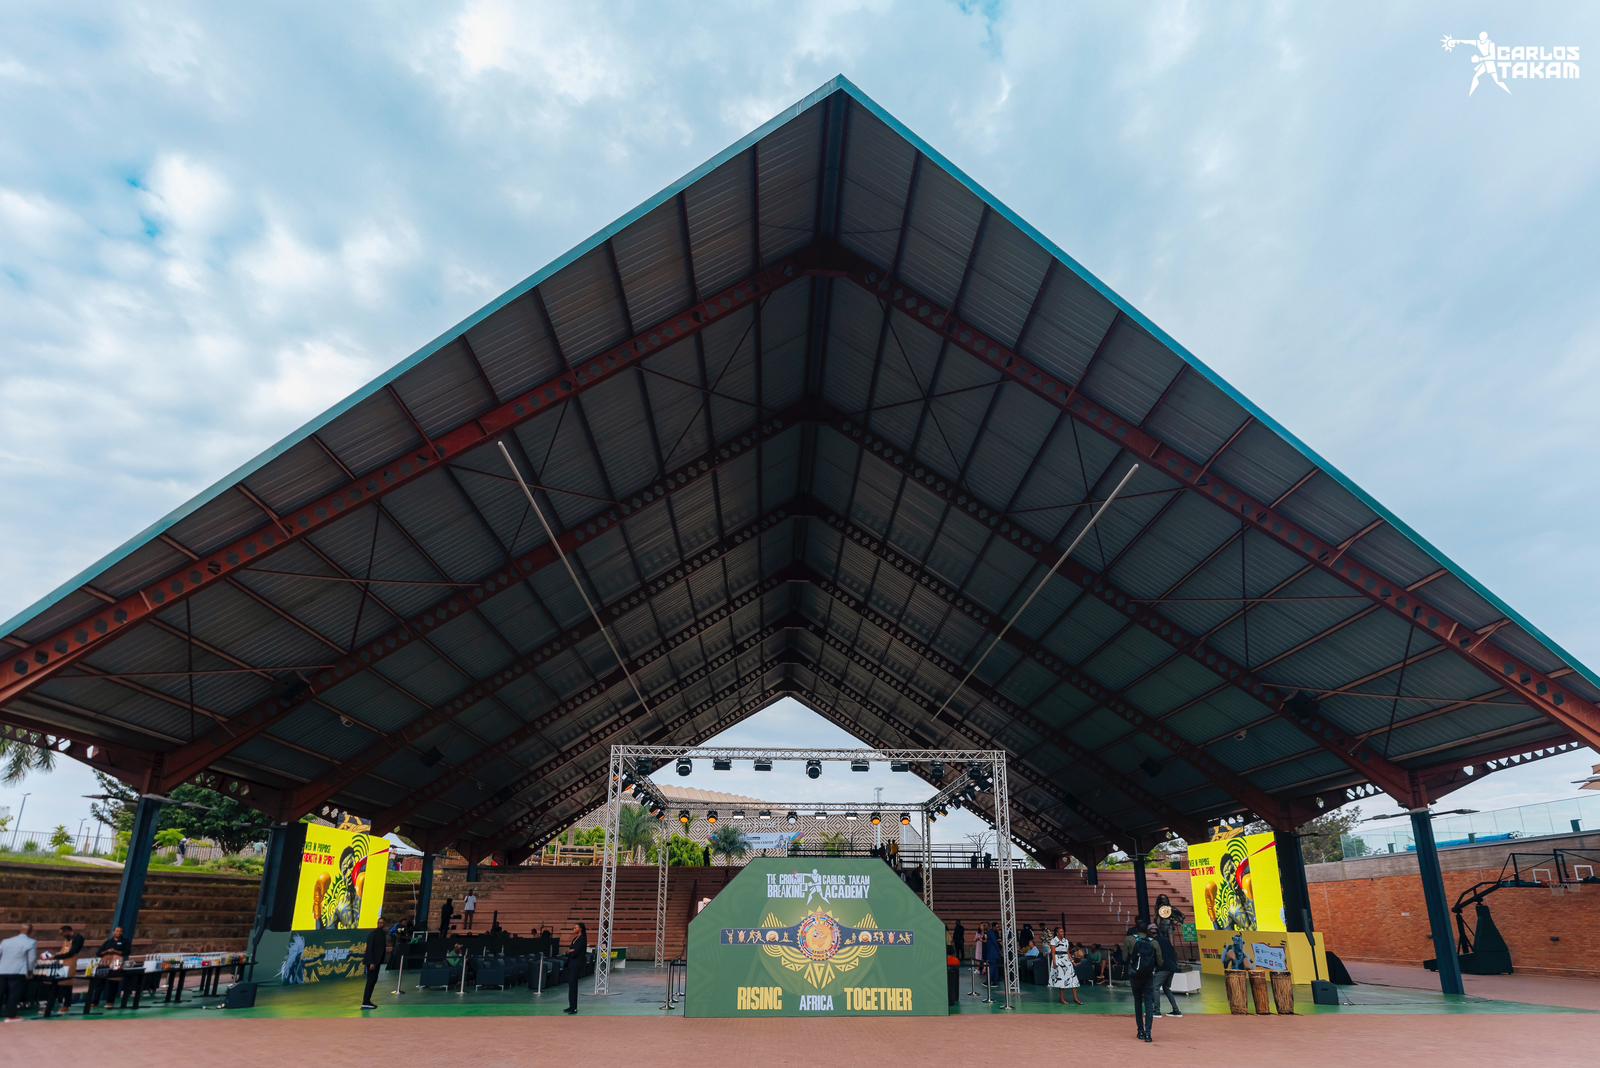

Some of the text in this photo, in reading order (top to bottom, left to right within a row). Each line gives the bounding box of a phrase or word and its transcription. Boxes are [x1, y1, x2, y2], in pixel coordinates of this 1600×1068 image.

[822, 875, 870, 885] CARLOS TAKAM
[767, 884, 805, 898] BREAKING
[824, 885, 870, 899] ACADEMY
[737, 987, 912, 1011] RISING AFRICA TOGETHER
